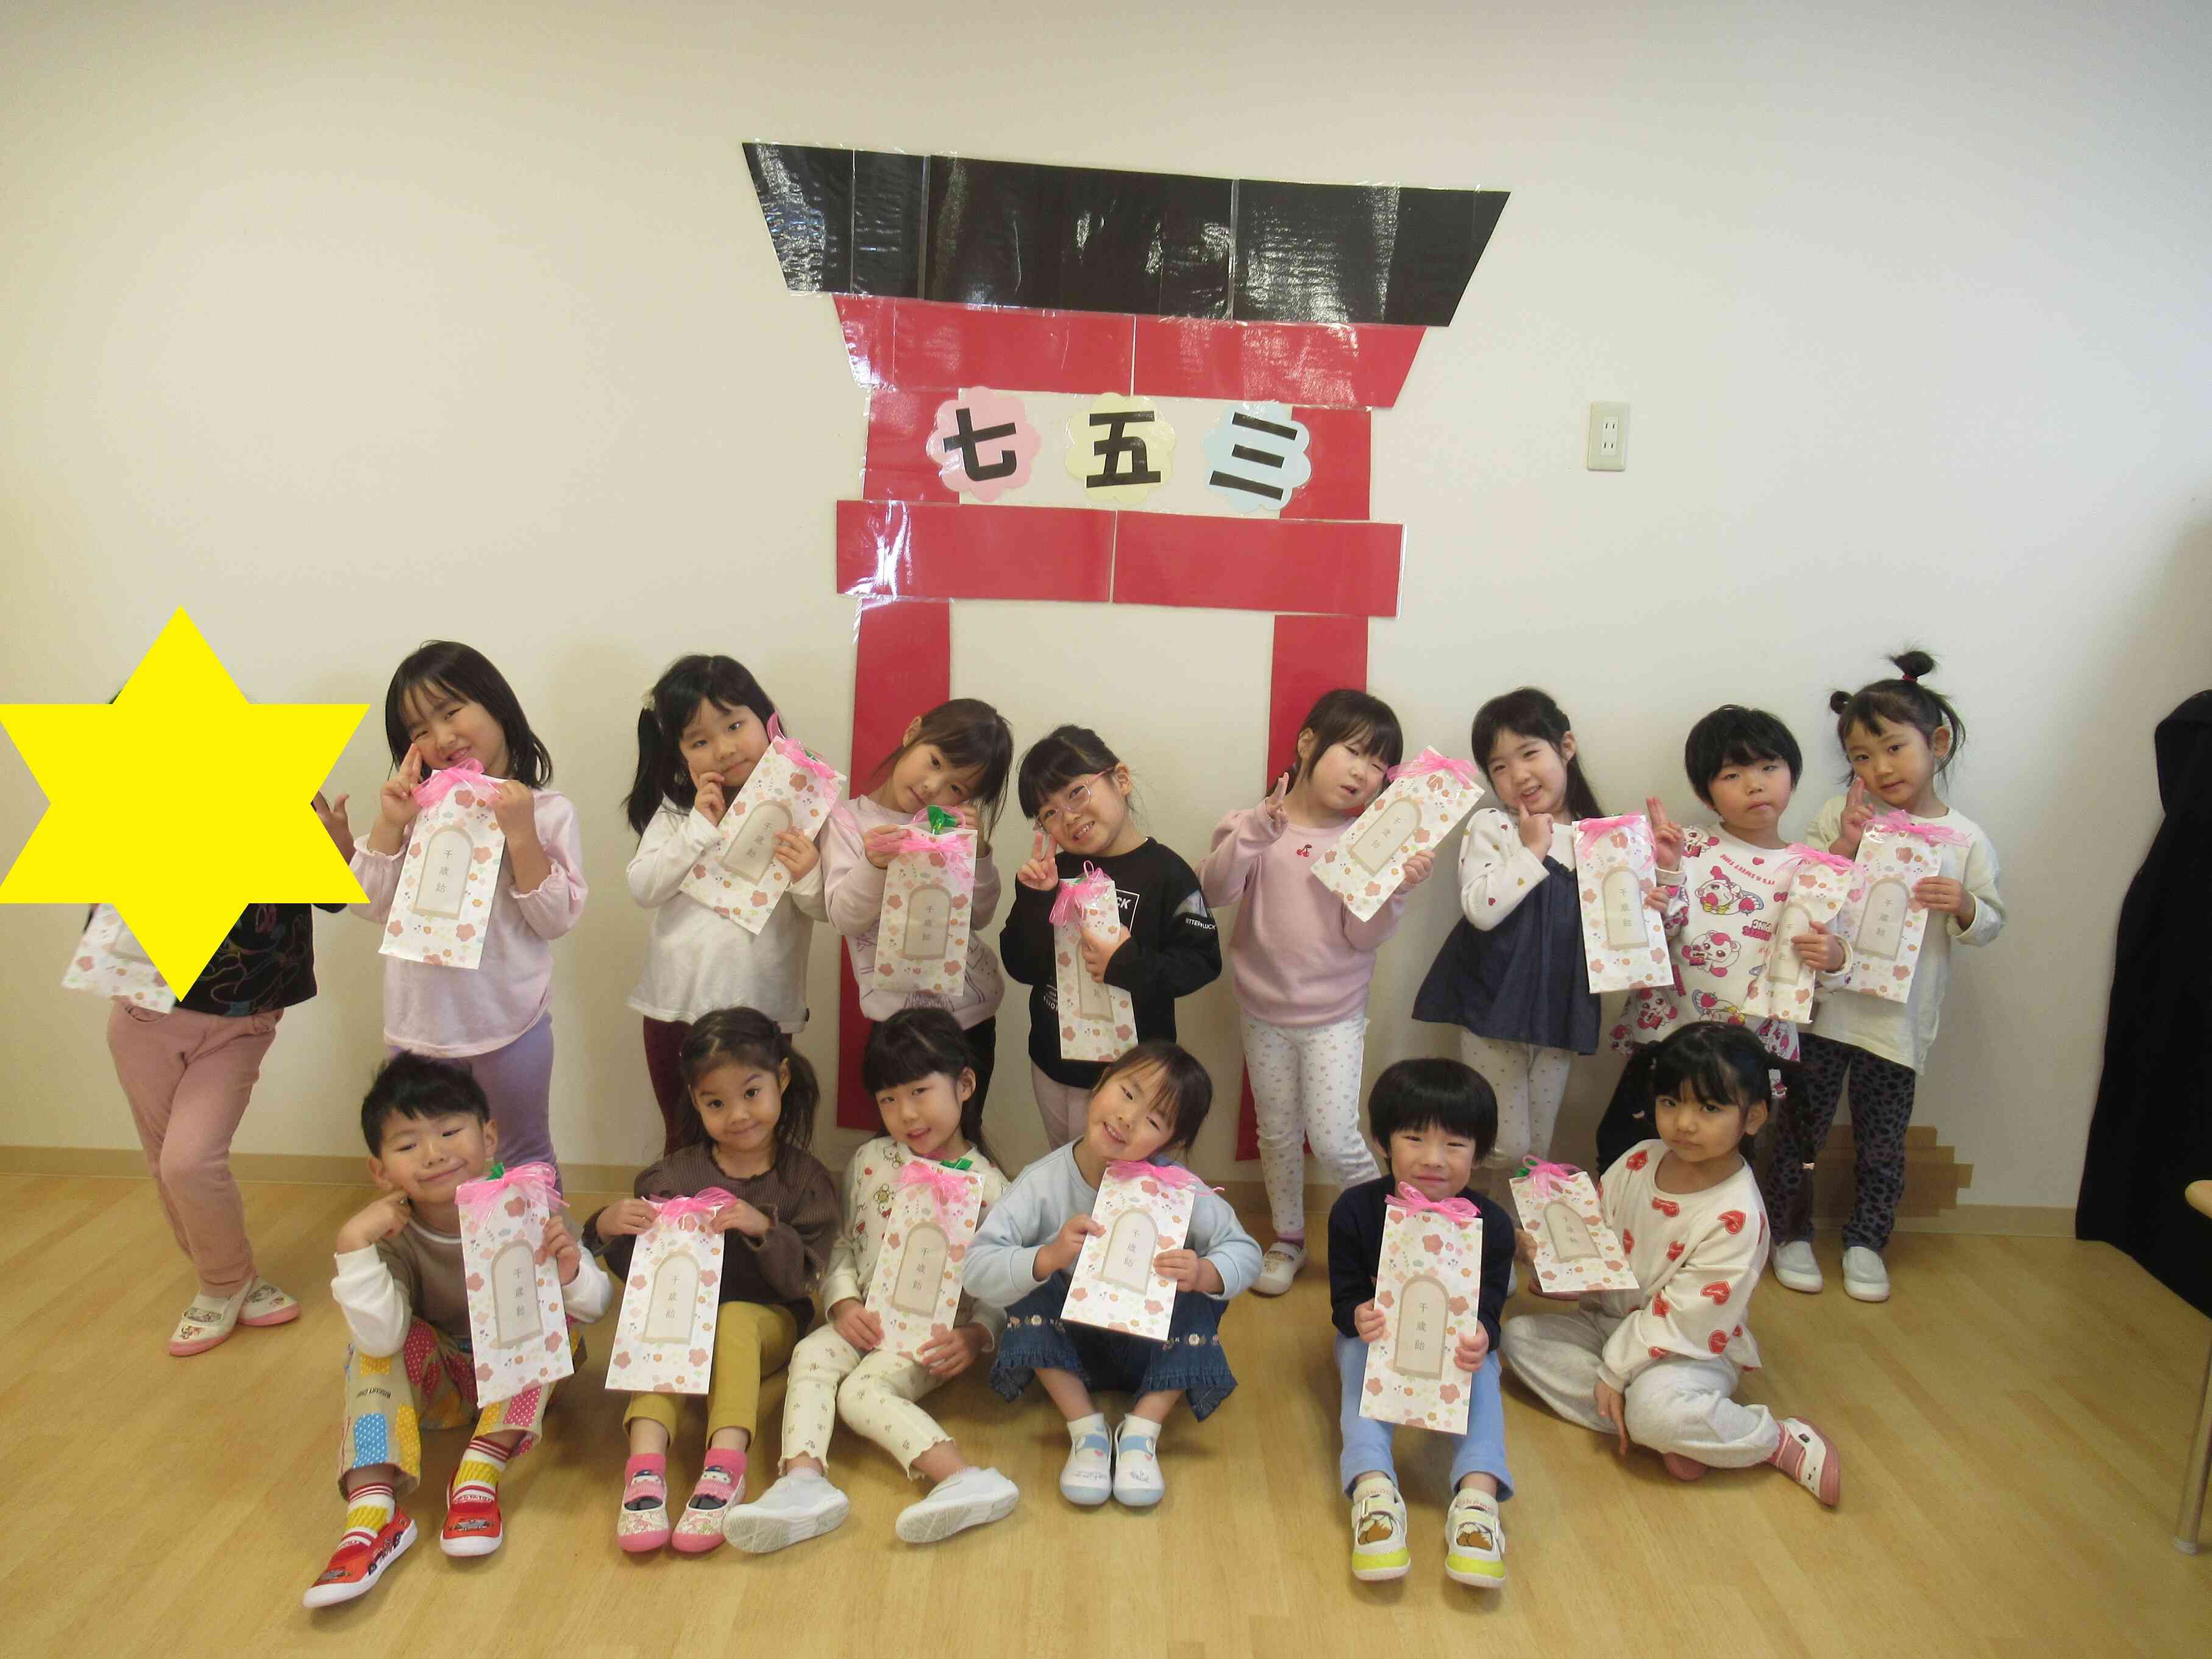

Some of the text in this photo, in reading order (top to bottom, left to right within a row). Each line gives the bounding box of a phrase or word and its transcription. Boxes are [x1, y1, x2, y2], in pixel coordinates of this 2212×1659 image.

[943, 407, 1298, 501] 七五三
[435, 849, 453, 893] 千歳飴
[1117, 896, 1132, 910] CK
[1414, 1302, 1428, 1351] 千歳飴
